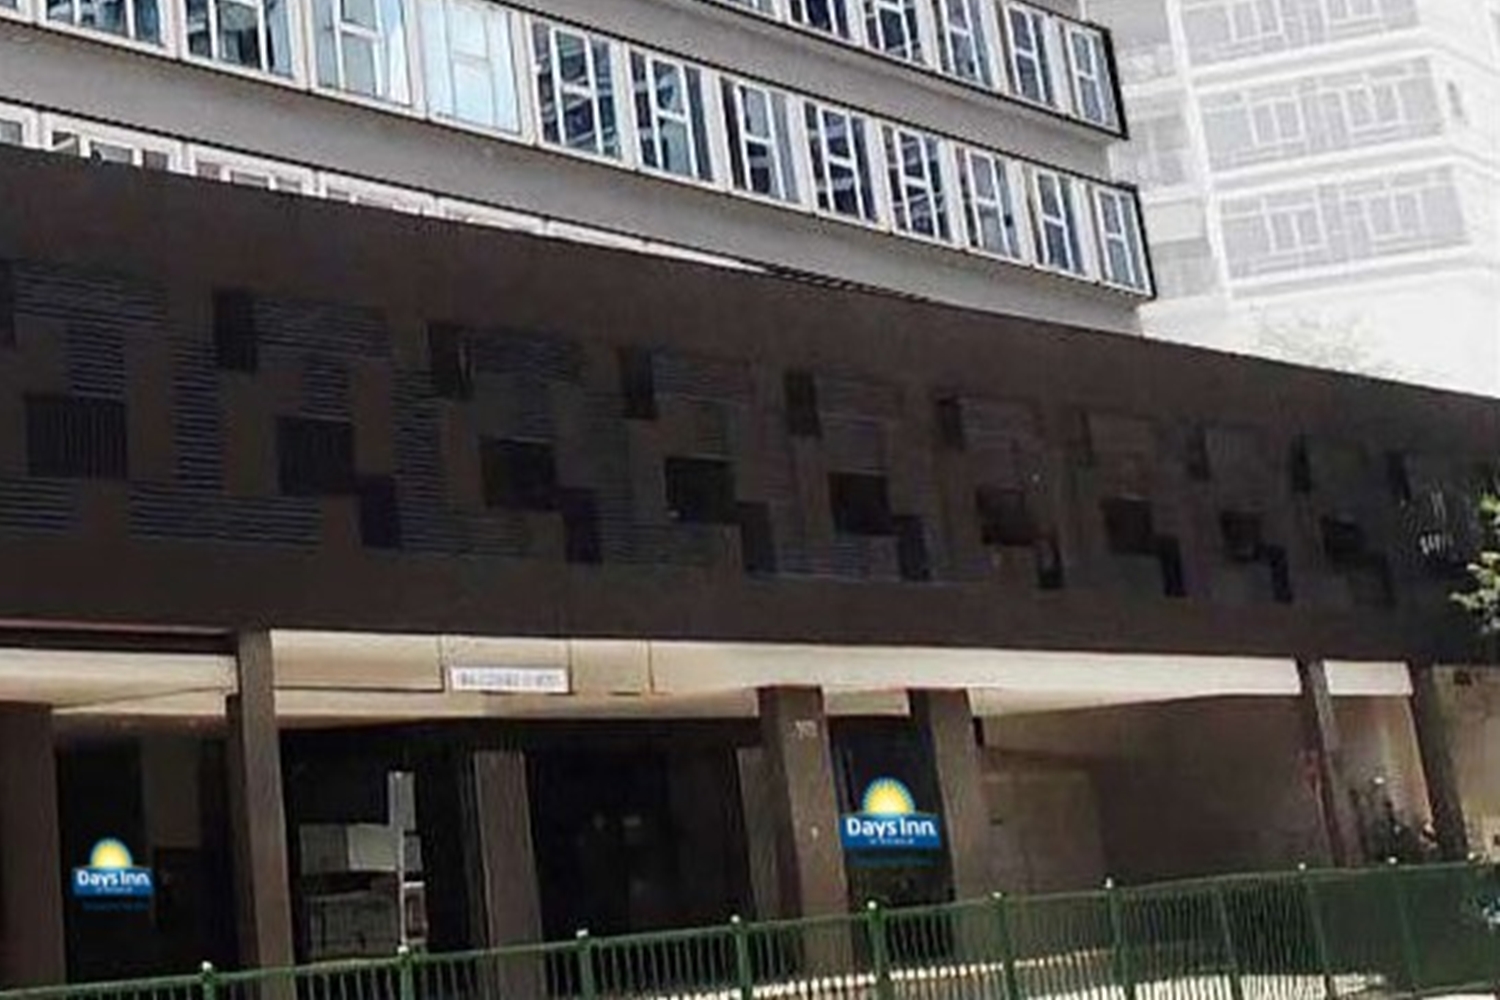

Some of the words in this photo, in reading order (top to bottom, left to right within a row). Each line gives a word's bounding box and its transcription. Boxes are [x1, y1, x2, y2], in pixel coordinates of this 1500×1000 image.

[846, 817, 897, 838] Days
[901, 816, 937, 836] Inn
[76, 870, 119, 888] Days
[120, 870, 150, 887] Inn
